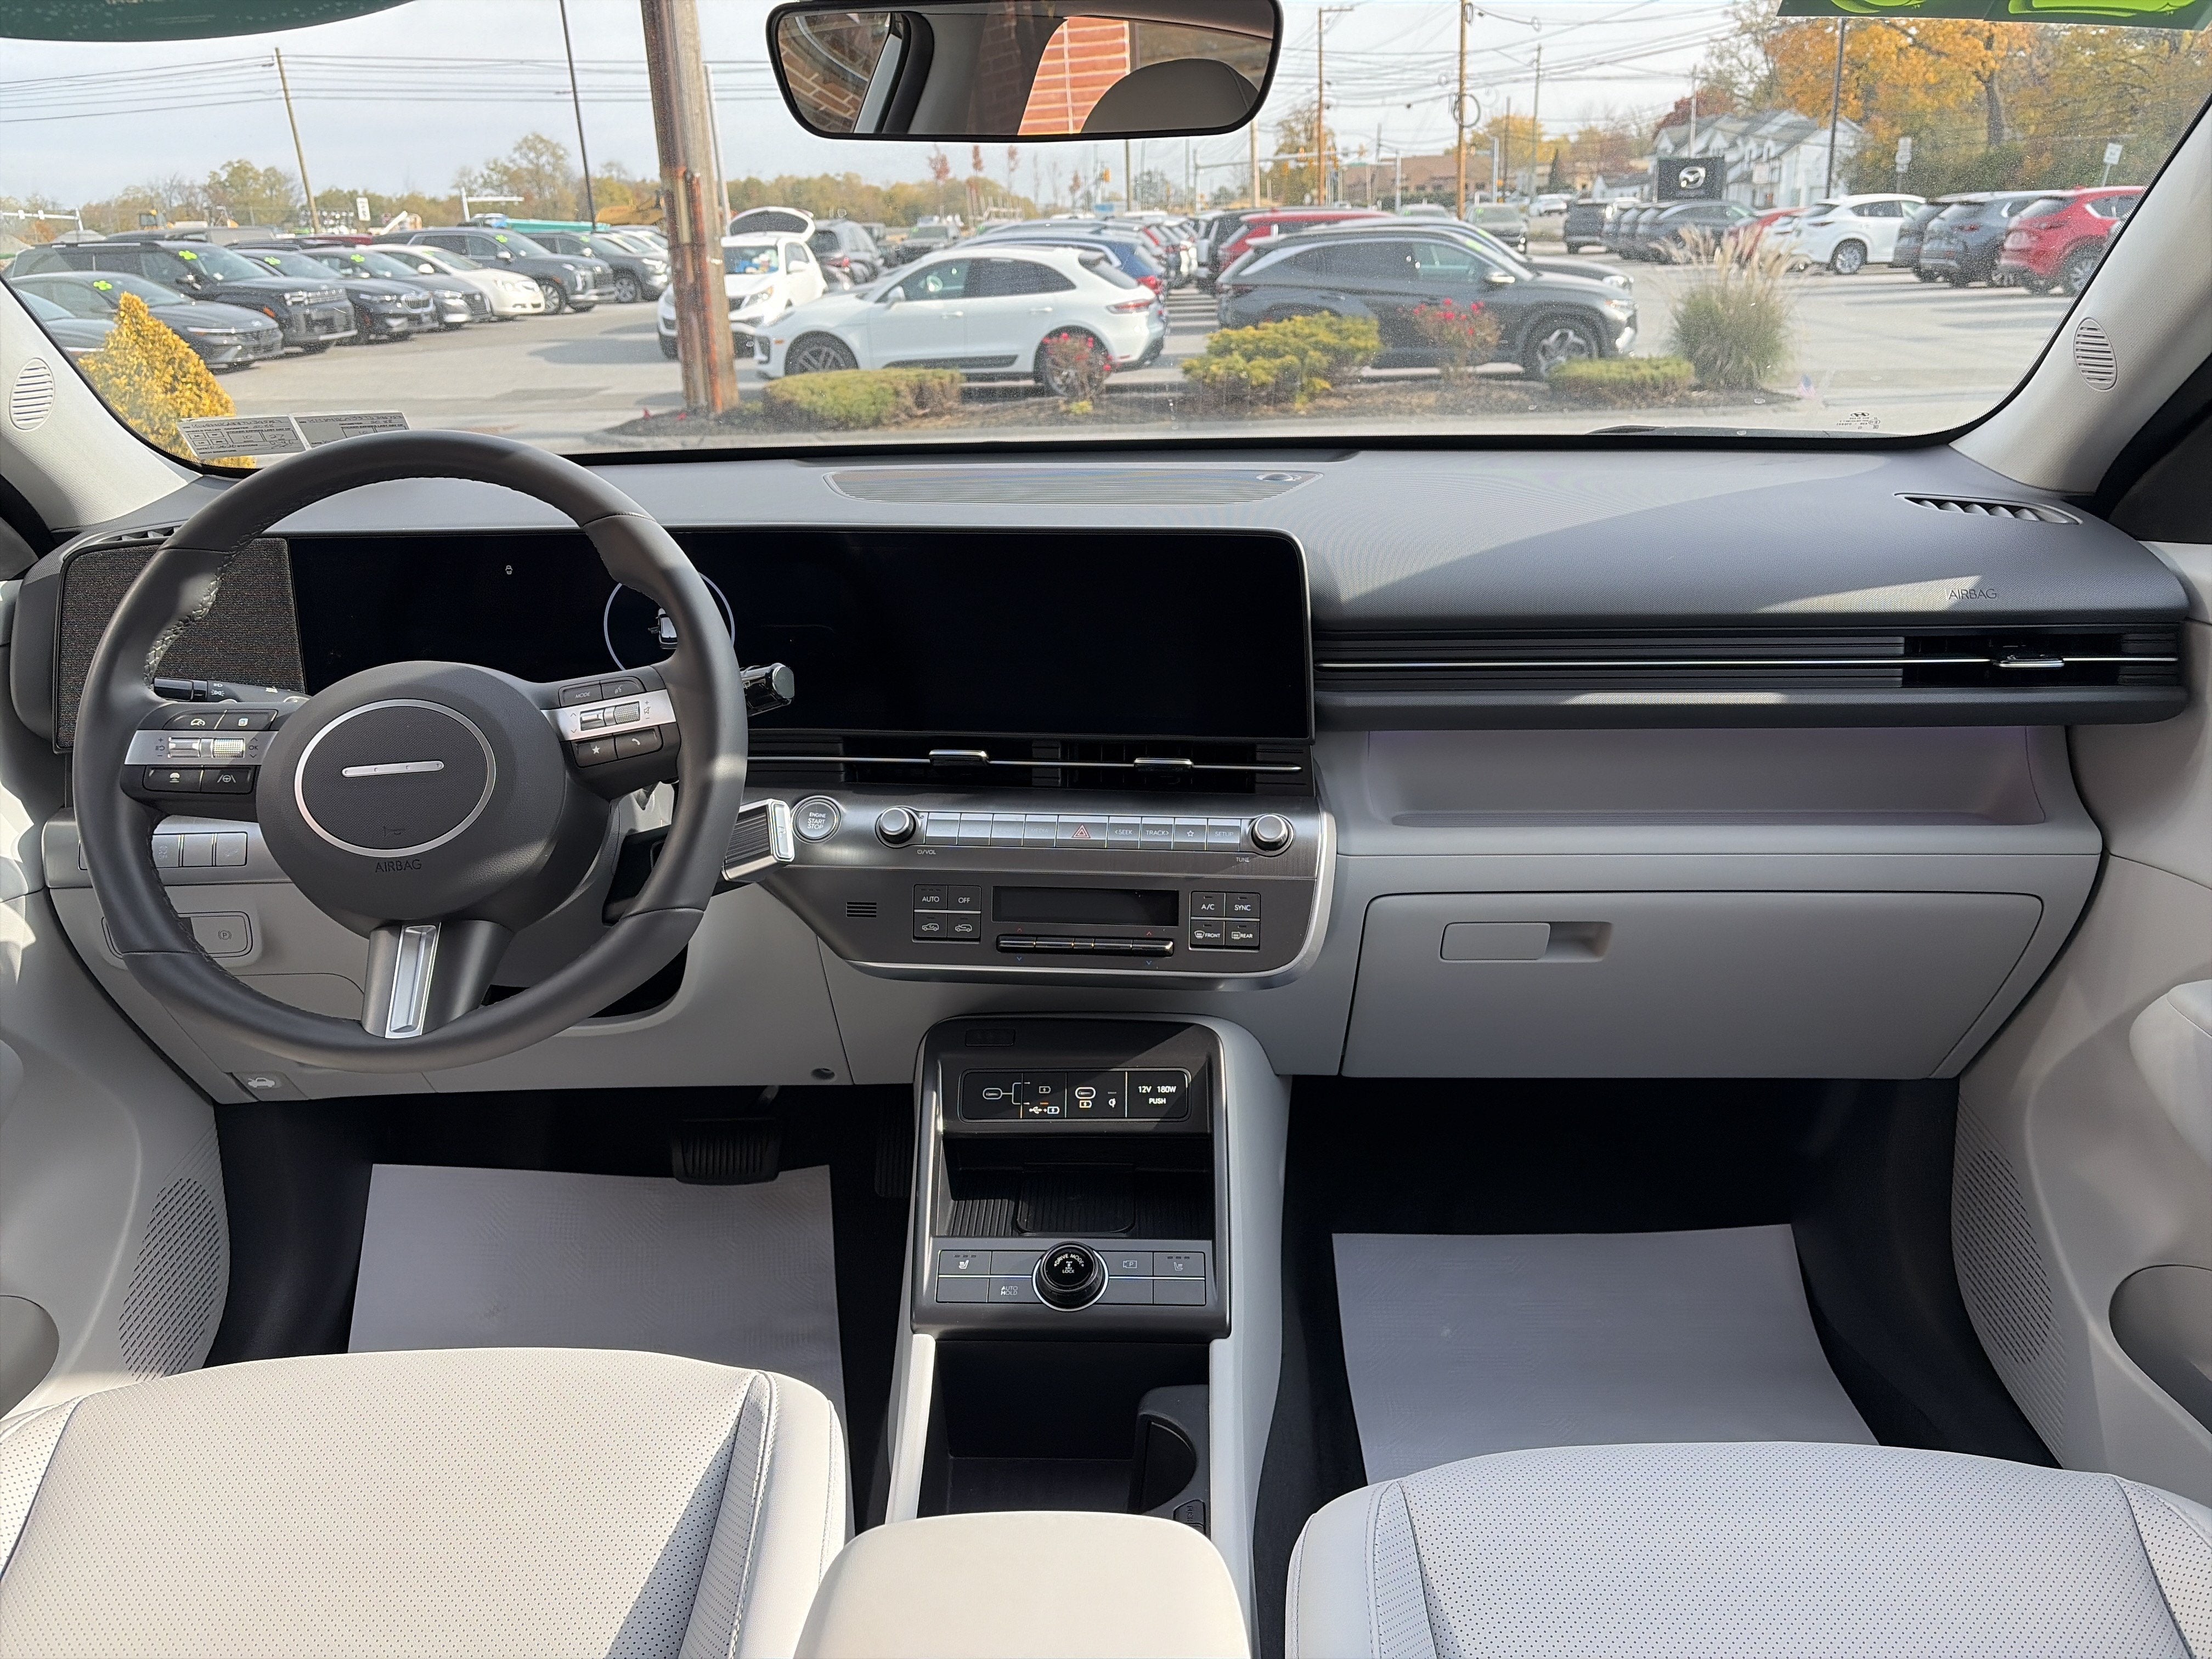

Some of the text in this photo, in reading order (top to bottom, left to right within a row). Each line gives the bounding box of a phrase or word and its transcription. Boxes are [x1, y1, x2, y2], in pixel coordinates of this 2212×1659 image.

[1948, 588, 1997, 600] AIRBAG
[375, 859, 422, 873] AIRBAG
[1156, 1085, 1177, 1093] 180W
[1054, 1253, 1085, 1265] DRIVE MODE
